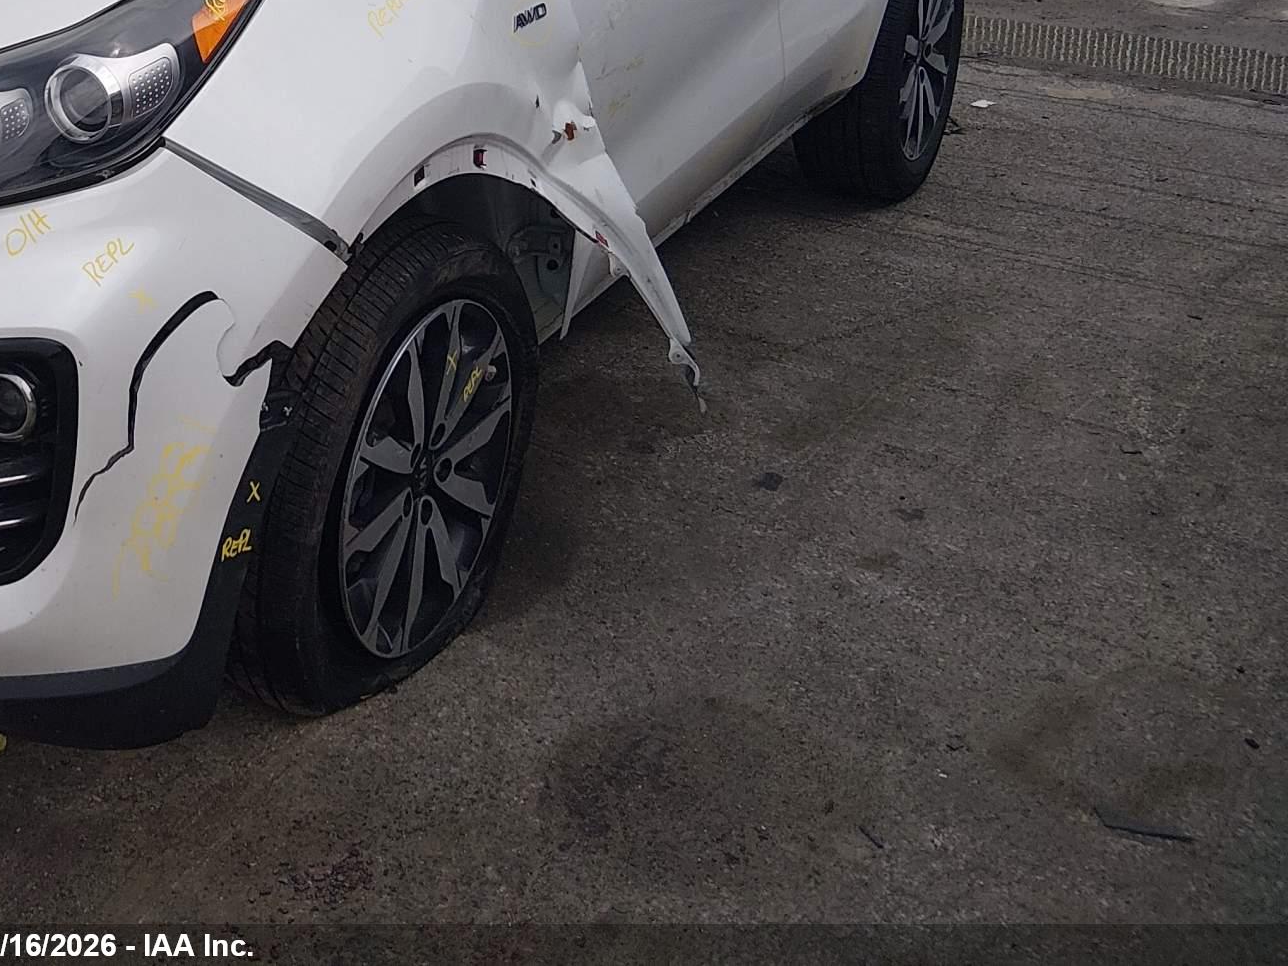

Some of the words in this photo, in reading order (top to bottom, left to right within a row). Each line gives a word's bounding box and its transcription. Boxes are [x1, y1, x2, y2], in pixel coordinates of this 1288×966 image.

[513, 2, 548, 34] AWD
[81, 237, 136, 287] REPL
[221, 528, 252, 563] REPL
